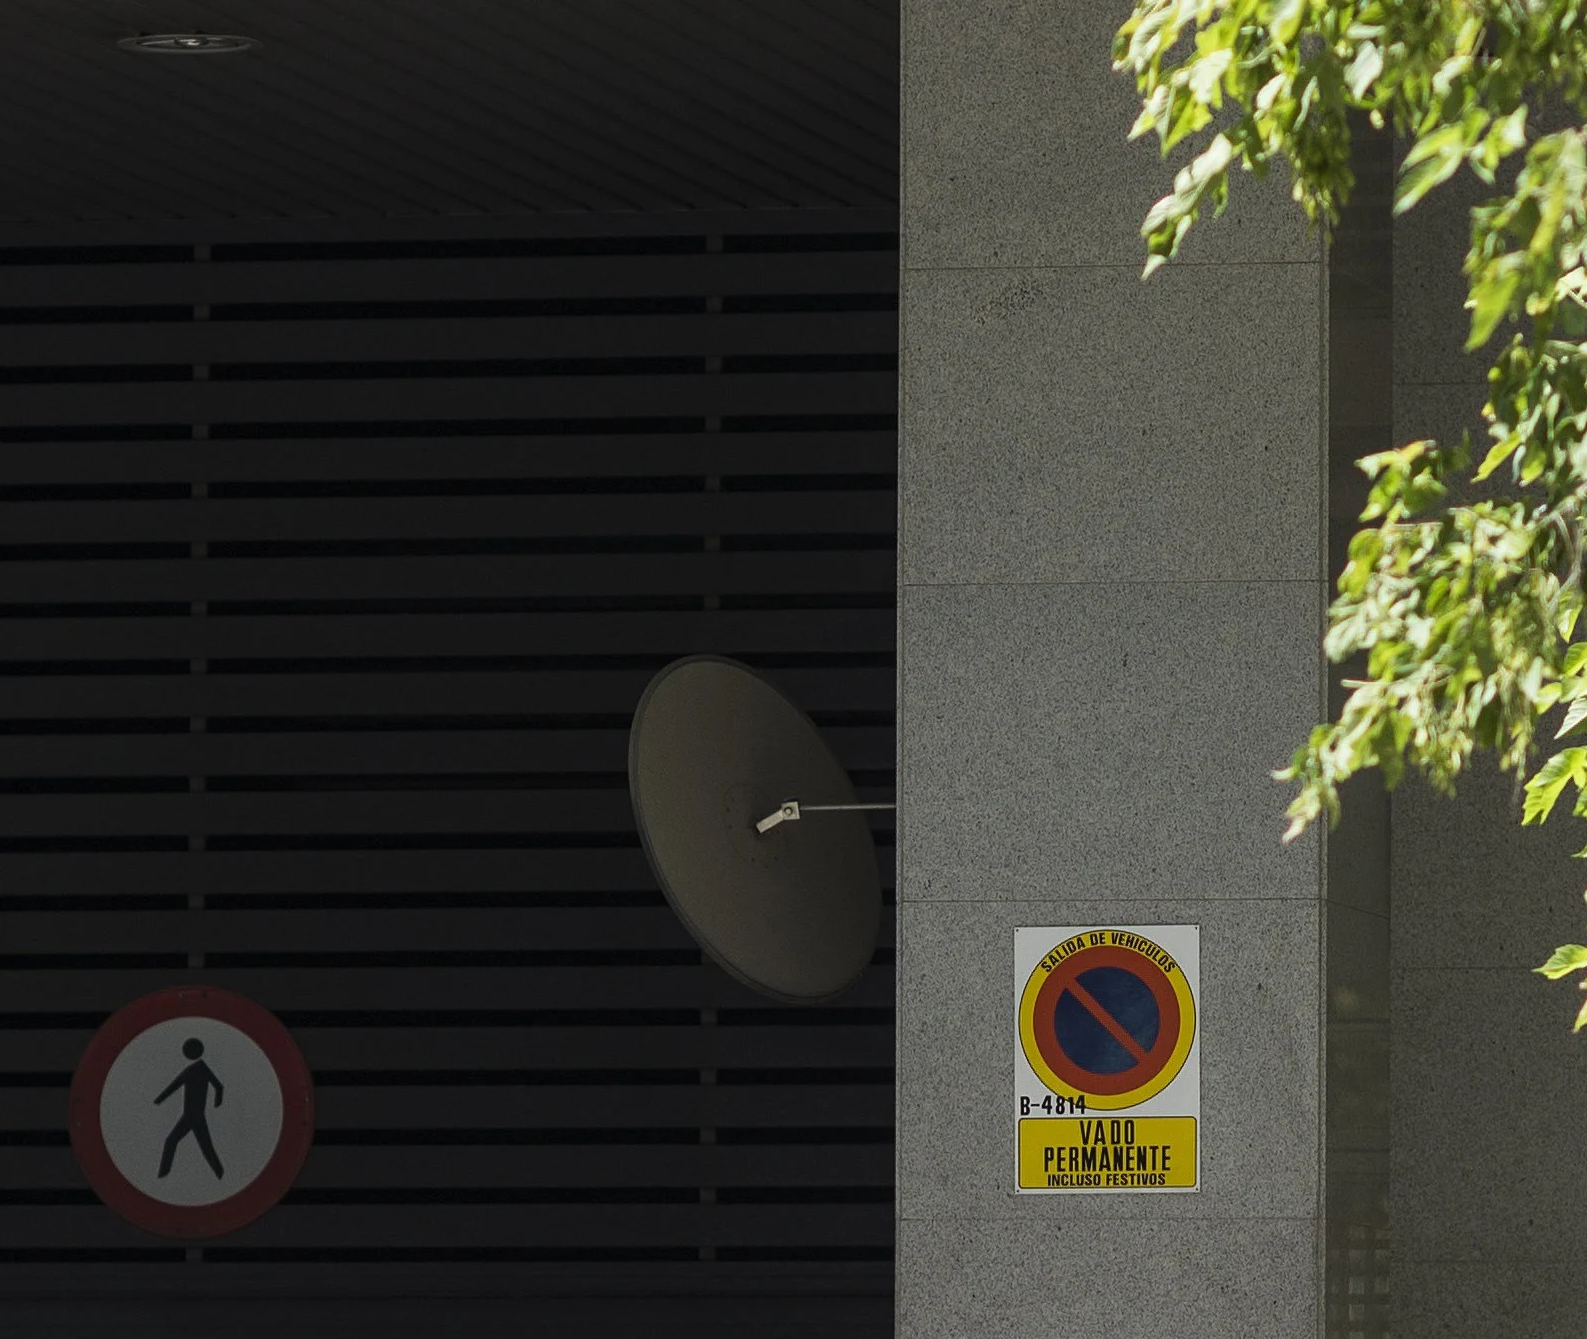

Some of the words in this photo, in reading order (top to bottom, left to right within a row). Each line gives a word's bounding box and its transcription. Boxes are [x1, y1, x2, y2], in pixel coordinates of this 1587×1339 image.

[1040, 936, 1086, 973] SALIDA
[1089, 932, 1106, 946] DE
[1110, 932, 1177, 973] VEHICULOS
[1019, 1094, 1086, 1116] B-4814
[1079, 1119, 1134, 1146] VADO
[1043, 1145, 1171, 1173] PERMANENTE
[1047, 1173, 1101, 1187] INCLUSO
[1105, 1172, 1166, 1187] FESTIVOS
